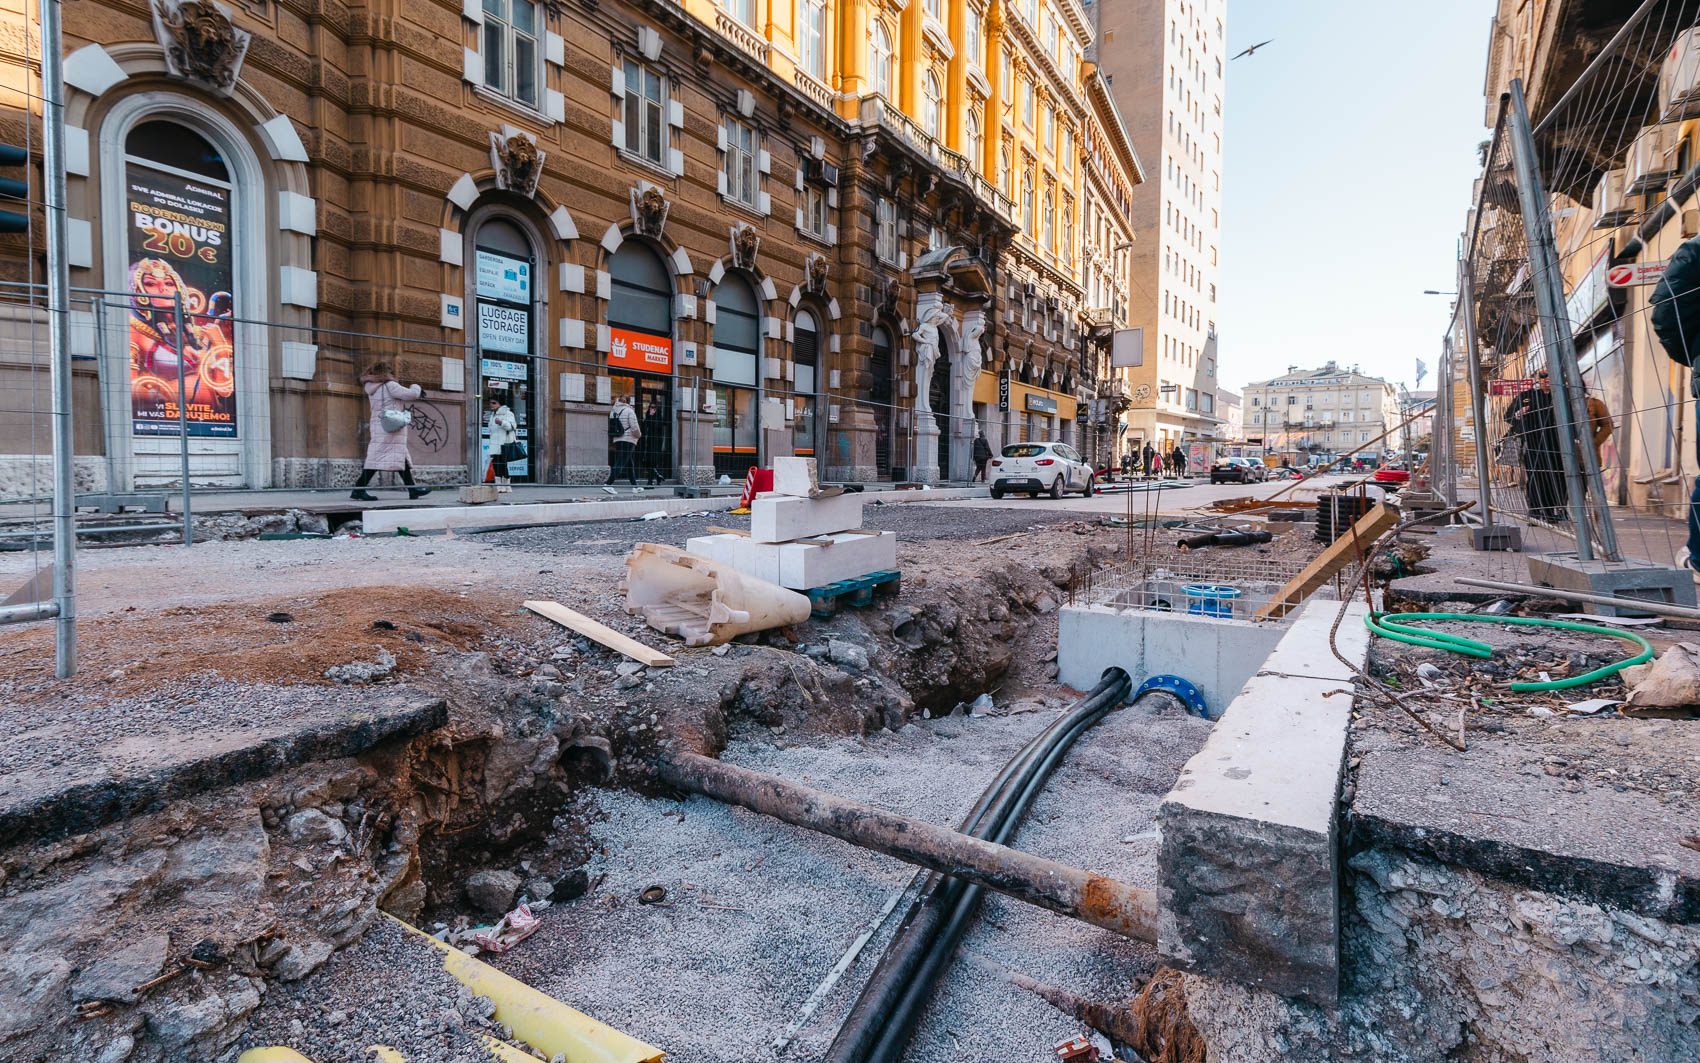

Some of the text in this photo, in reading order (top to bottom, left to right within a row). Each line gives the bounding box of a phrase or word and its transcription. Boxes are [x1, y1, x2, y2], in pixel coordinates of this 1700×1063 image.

[131, 184, 223, 213] SVE ADMIRAL LOKACIJE
[184, 184, 224, 200] ADMIRAL
[153, 196, 204, 214] PO DOLASKU
[135, 212, 222, 246] BONUS
[142, 227, 195, 258] 20
[481, 306, 526, 324] LUGGAGE
[482, 318, 526, 335] STORAGE
[482, 332, 525, 345] OPEN EVERY DAY
[632, 342, 669, 355] STUDENAC
[647, 354, 667, 363] MARKET
[1000, 378, 1008, 408] eduro
[164, 402, 214, 412] SLVITE,
